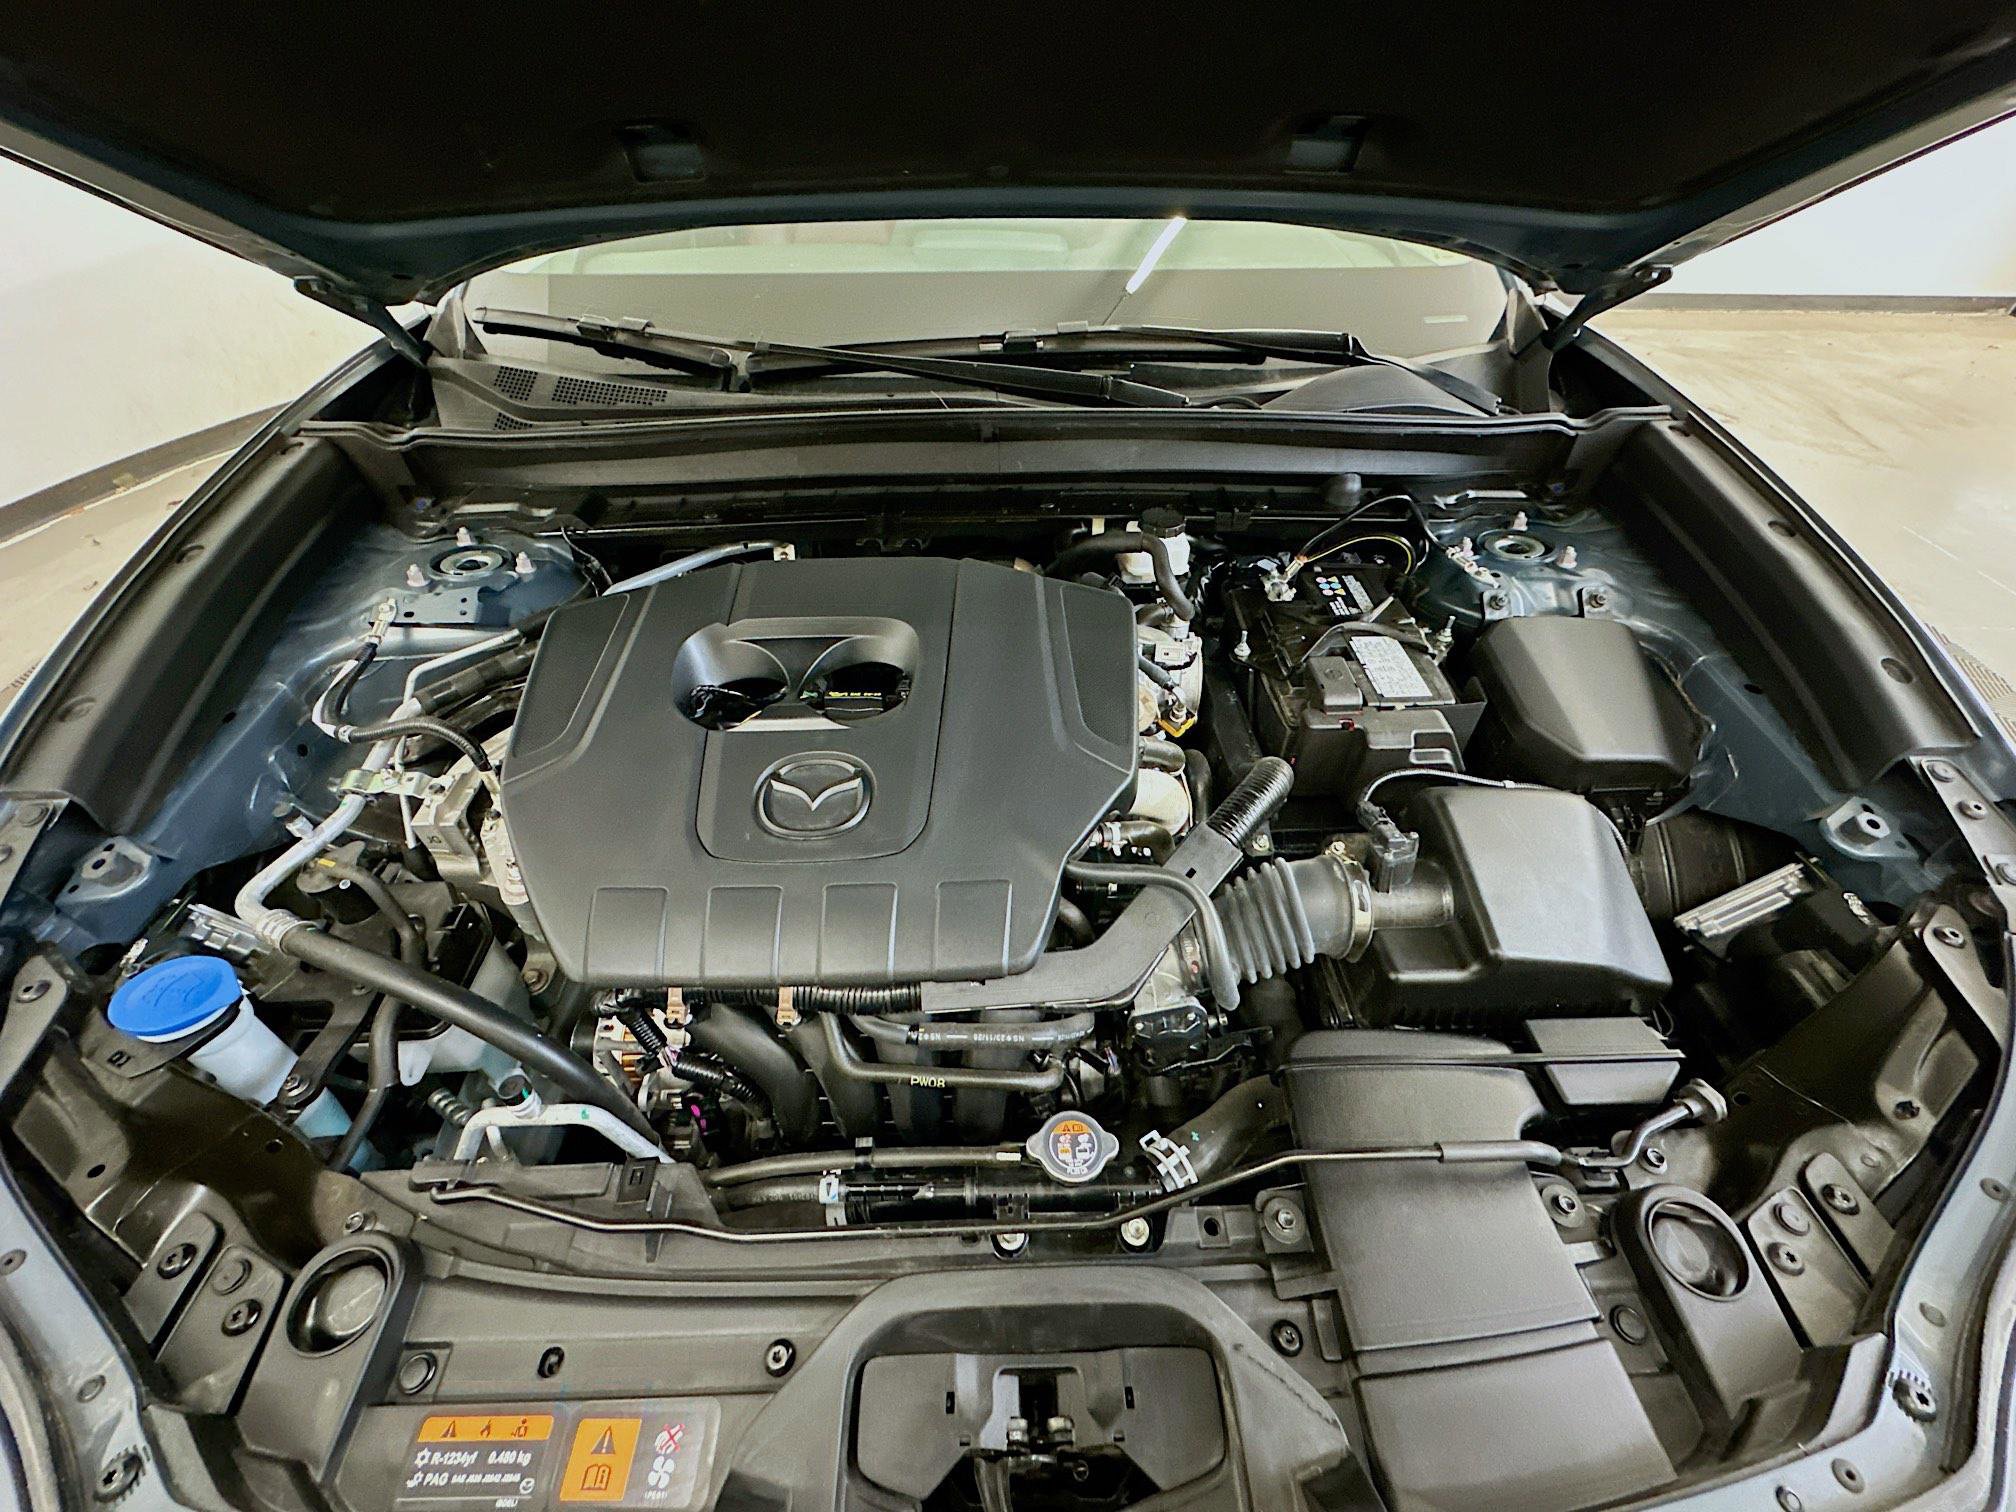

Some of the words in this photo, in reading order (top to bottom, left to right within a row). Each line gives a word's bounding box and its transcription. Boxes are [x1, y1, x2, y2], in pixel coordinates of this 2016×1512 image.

[910, 1075, 946, 1088] PW08
[430, 1451, 478, 1467] R-1234yf
[516, 1450, 532, 1467] kg
[423, 1472, 449, 1486] PAG
